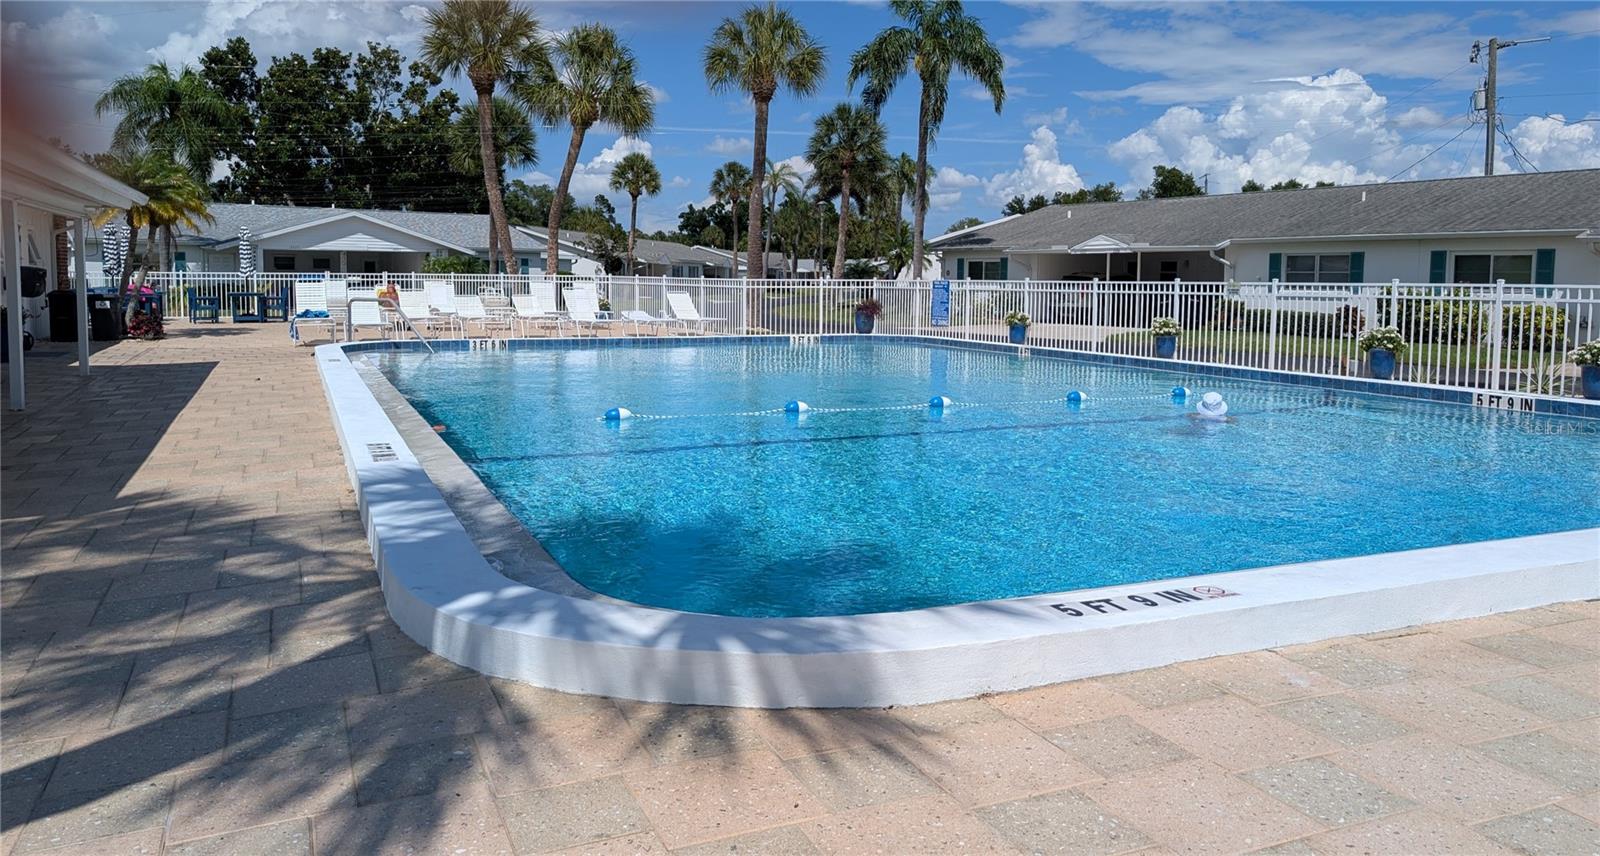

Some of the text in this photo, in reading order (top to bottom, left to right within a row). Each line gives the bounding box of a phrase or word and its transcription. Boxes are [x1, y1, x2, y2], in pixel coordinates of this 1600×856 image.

[472, 340, 477, 351] 3
[480, 340, 488, 351] FT
[499, 340, 507, 351] IN
[1477, 394, 1533, 412] 5 FT 9 IN
[1050, 604, 1084, 617] 5
[1080, 598, 1128, 614] FT
[1127, 594, 1158, 607] 9
[1153, 590, 1204, 603] IN
